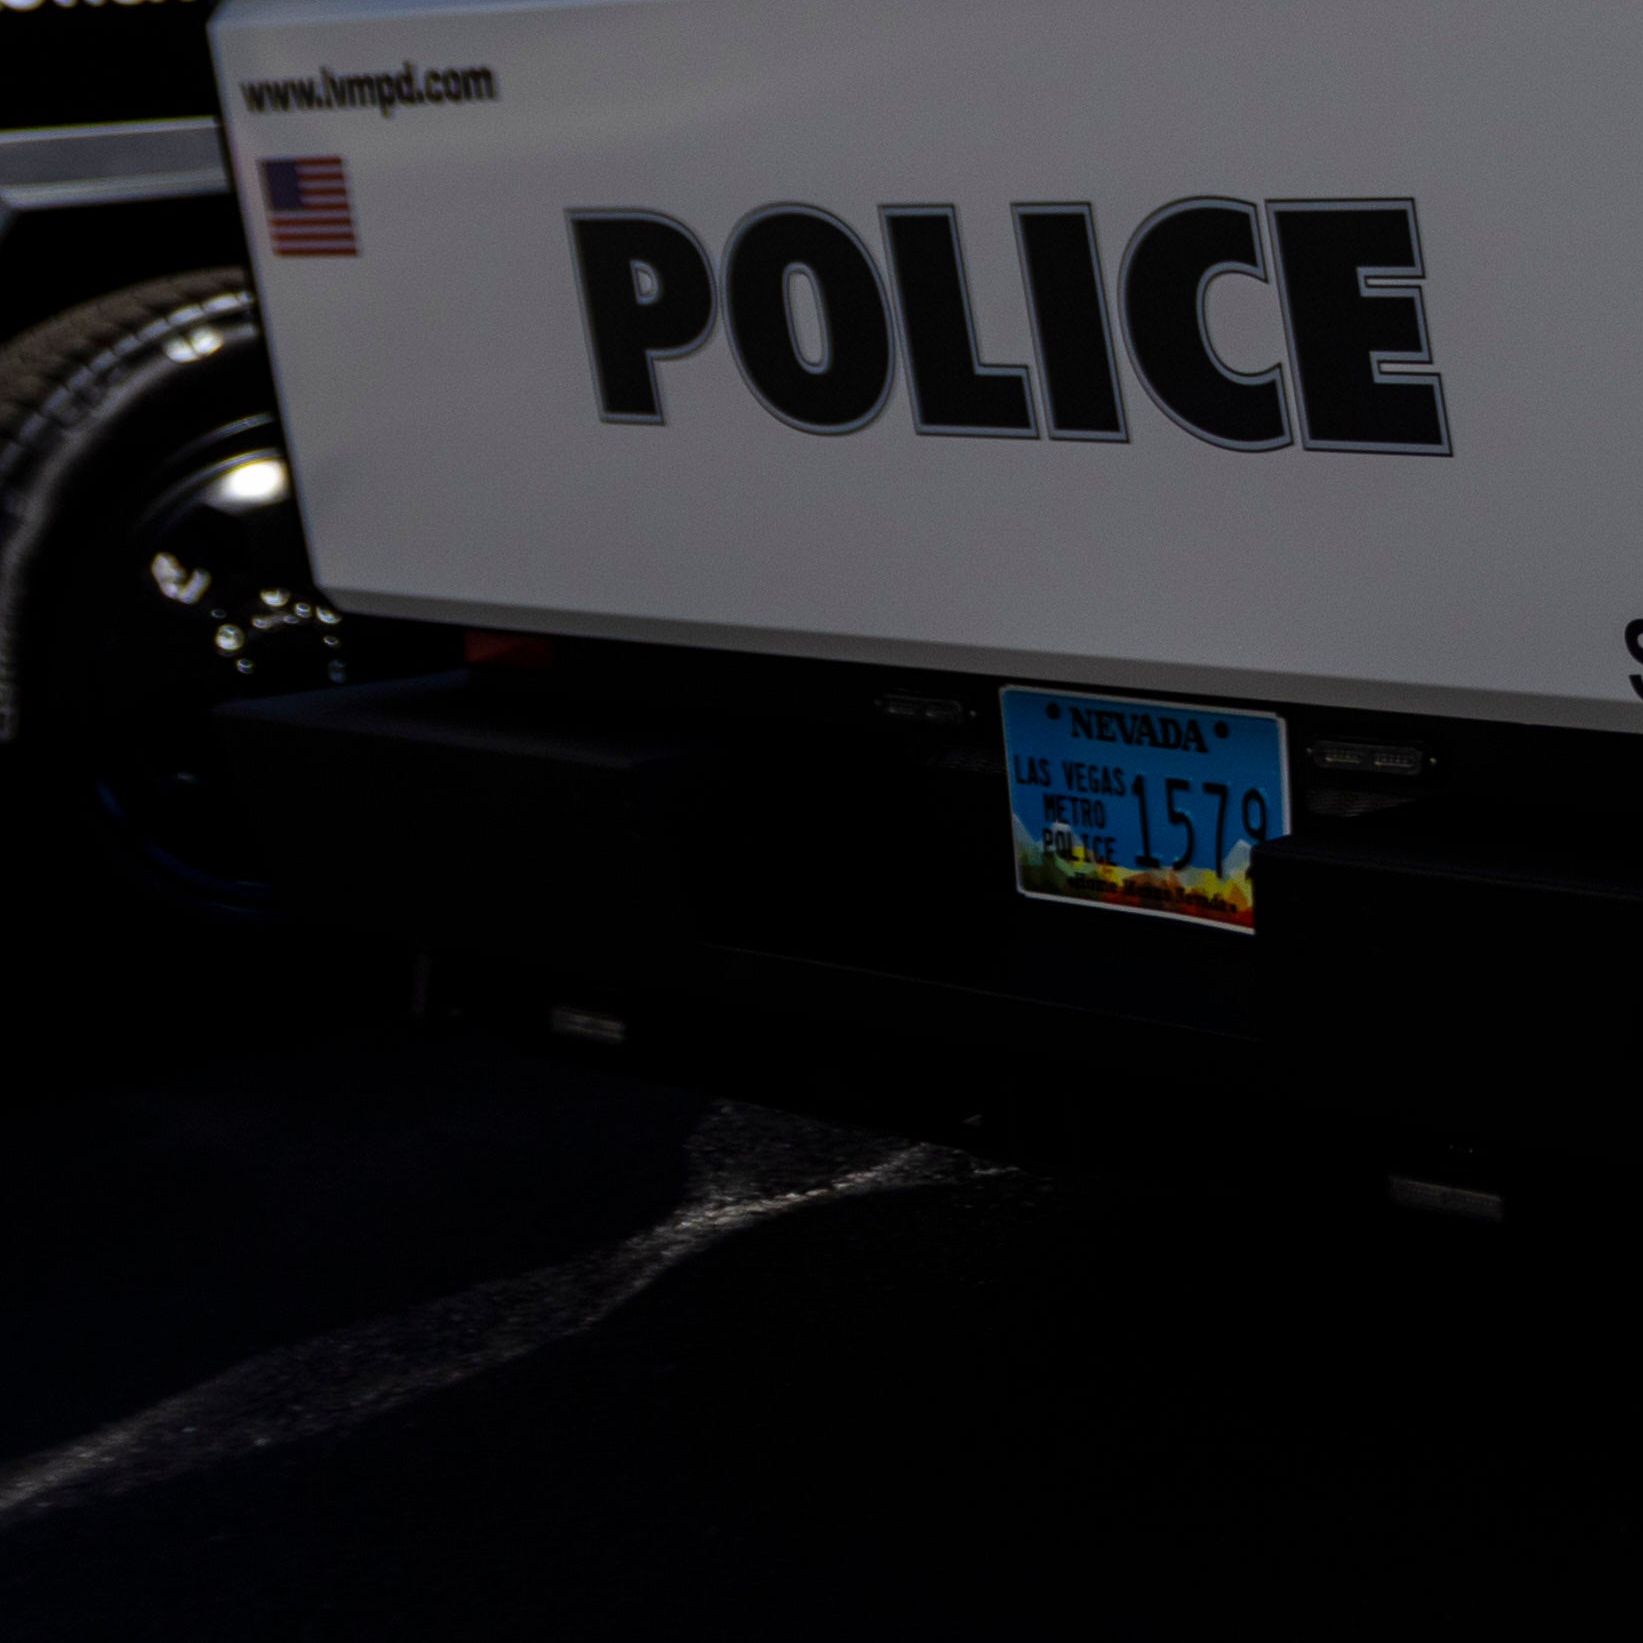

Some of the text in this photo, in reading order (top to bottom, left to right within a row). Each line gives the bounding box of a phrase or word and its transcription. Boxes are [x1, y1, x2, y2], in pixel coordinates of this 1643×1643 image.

[240, 61, 498, 118] www.lvmpd.com
[564, 195, 1454, 458] POLICE
[1069, 706, 1210, 754] NEVADA
[1013, 754, 1126, 797] LAS VEGAS
[1043, 794, 1106, 830] METRO
[1043, 828, 1117, 867] POLICE
